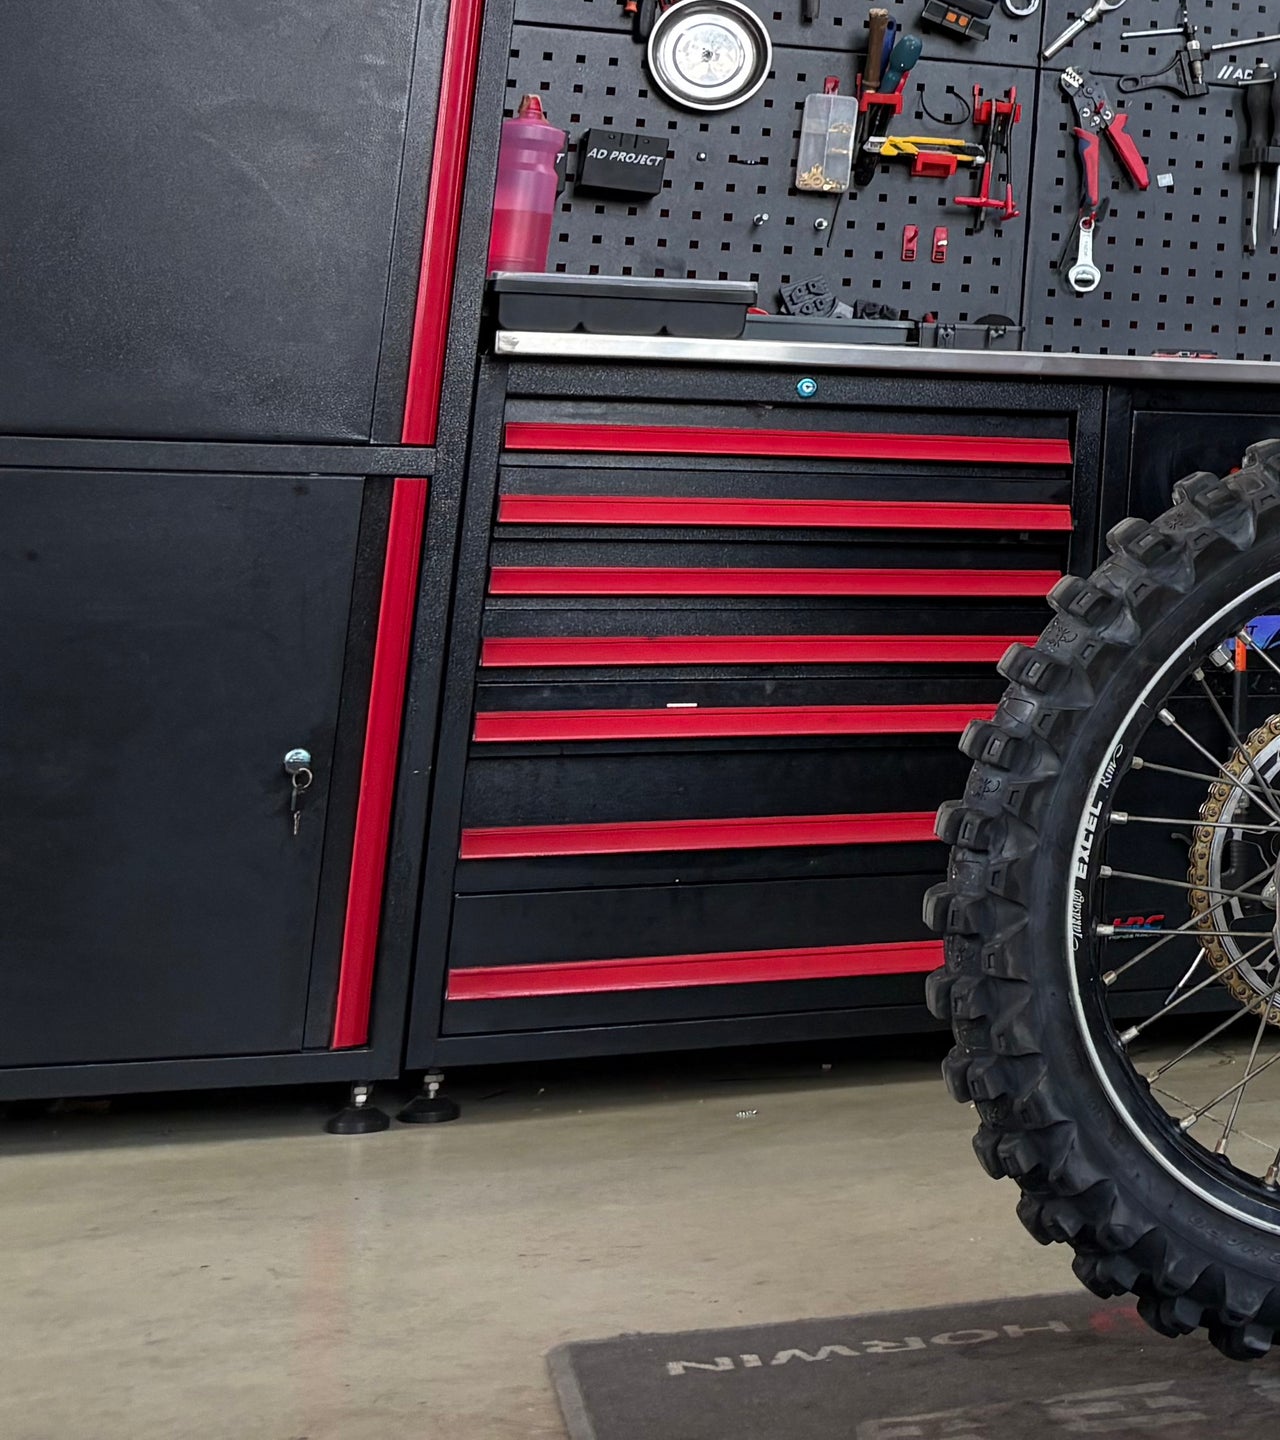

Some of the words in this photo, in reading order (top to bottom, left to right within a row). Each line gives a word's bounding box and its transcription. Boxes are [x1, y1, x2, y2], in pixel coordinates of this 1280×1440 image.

[587, 147, 608, 160] AD
[609, 150, 665, 166] PROJECT
[1075, 800, 1103, 880] EXCEL
[665, 1318, 1070, 1377] HORWIN
